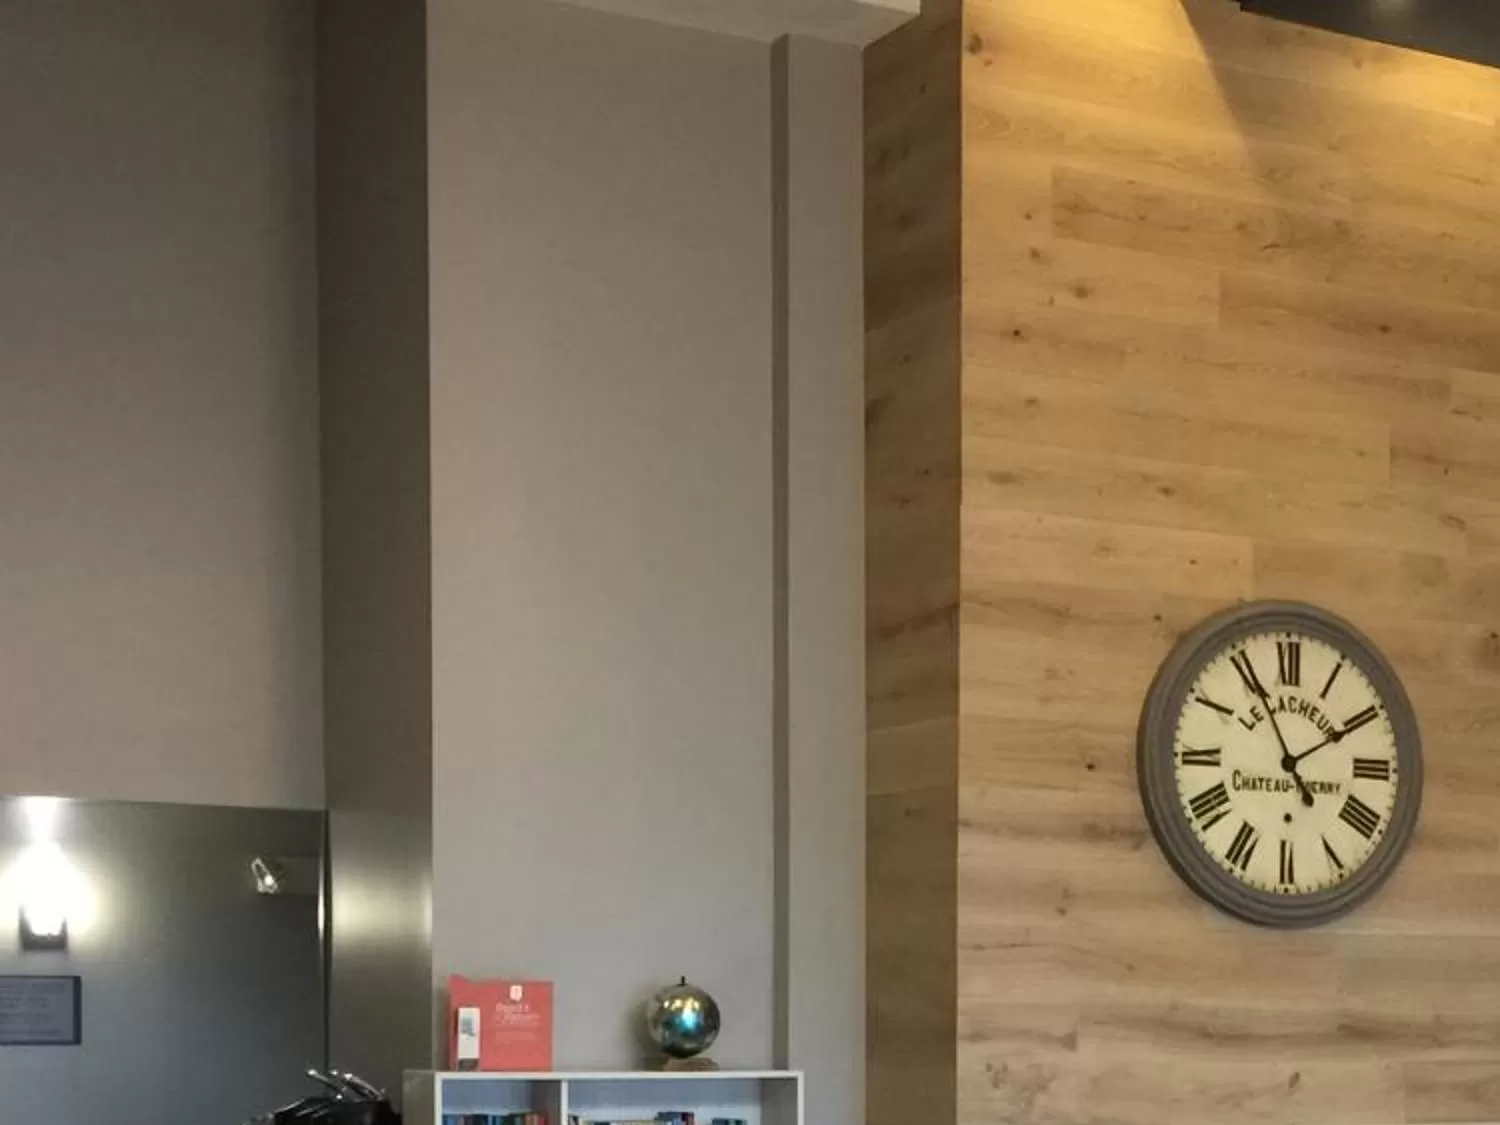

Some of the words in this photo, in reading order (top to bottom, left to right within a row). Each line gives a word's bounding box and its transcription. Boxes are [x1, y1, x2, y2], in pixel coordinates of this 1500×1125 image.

[1275, 641, 1300, 688] XII
[1320, 661, 1342, 699] I
[1238, 705, 1264, 732] LE
[1181, 743, 1222, 767] IX
[1352, 757, 1390, 781] III
[1188, 780, 1231, 831] VIII
[1225, 819, 1260, 871] VII
